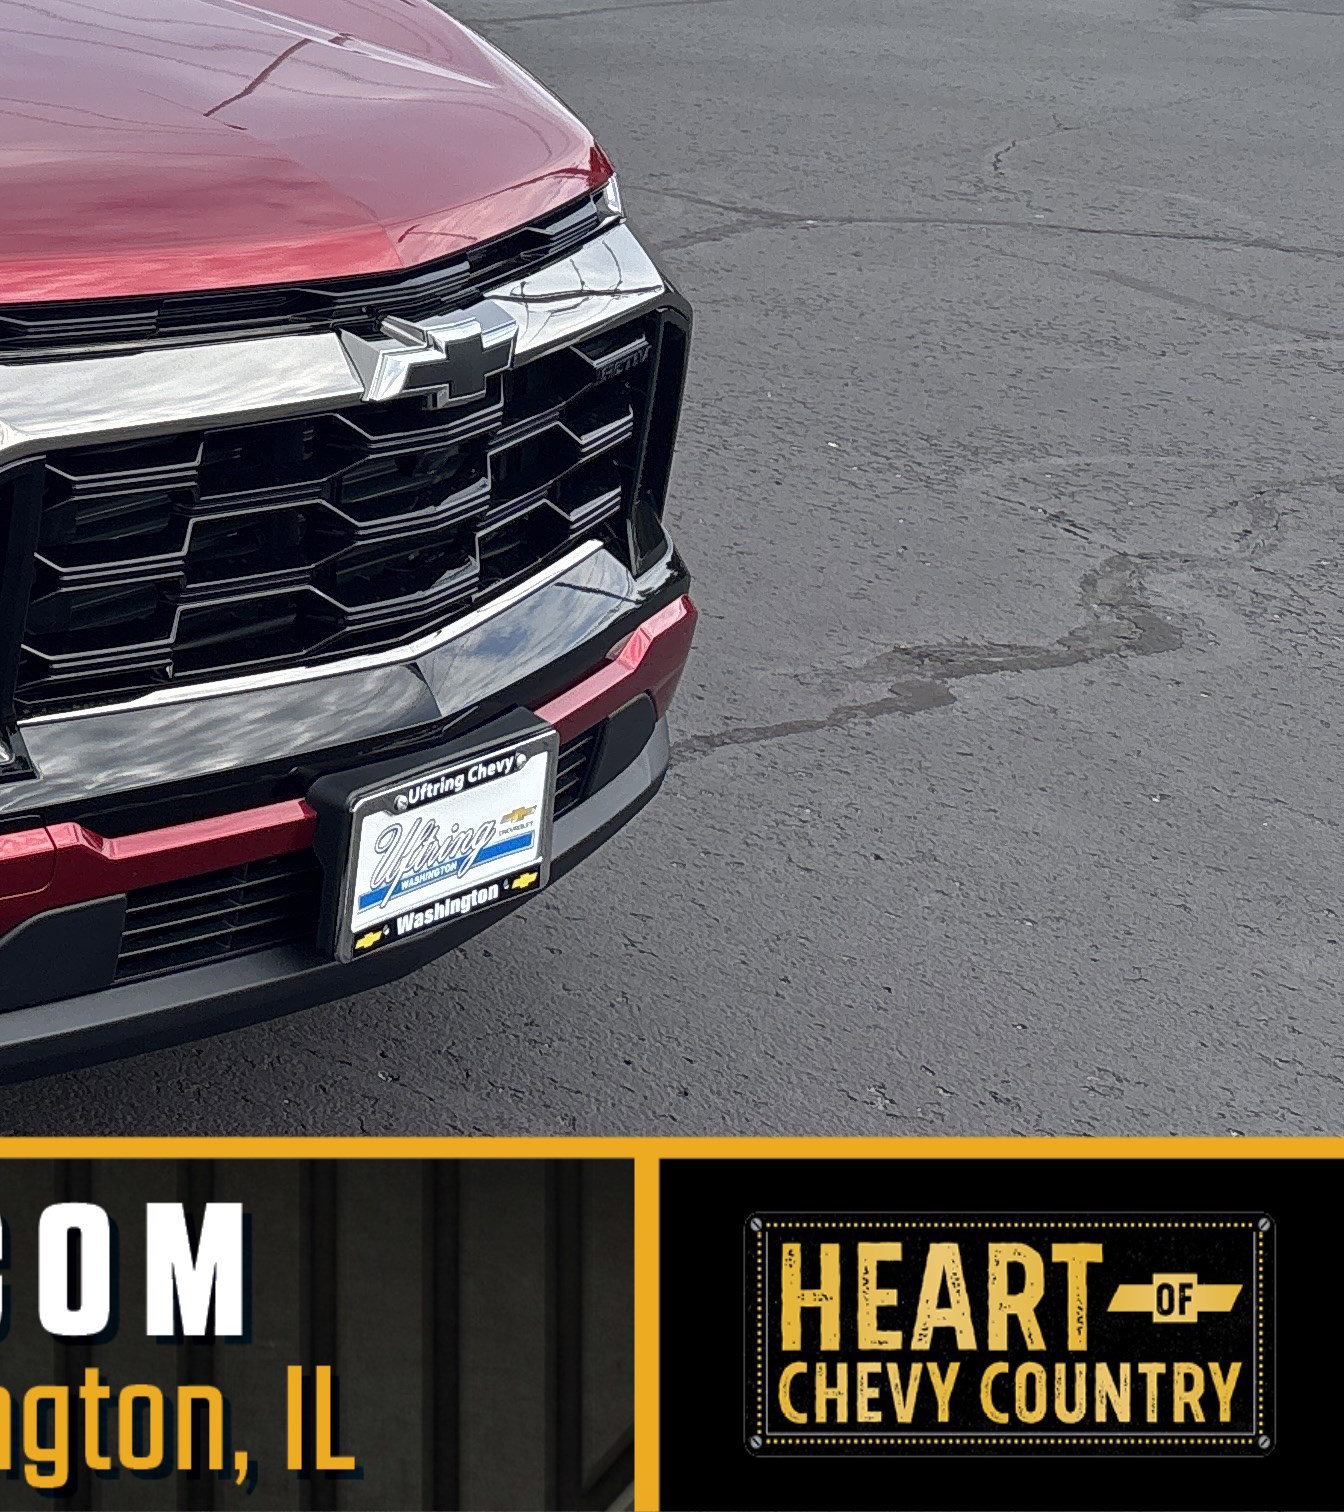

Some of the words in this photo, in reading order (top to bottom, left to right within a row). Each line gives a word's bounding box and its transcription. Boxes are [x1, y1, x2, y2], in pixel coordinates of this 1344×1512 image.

[407, 774, 465, 806] Uftring
[467, 754, 515, 785] Chevy
[370, 816, 498, 909] Uftring
[401, 860, 458, 890] WASHINGTON
[395, 882, 500, 936] Washington
